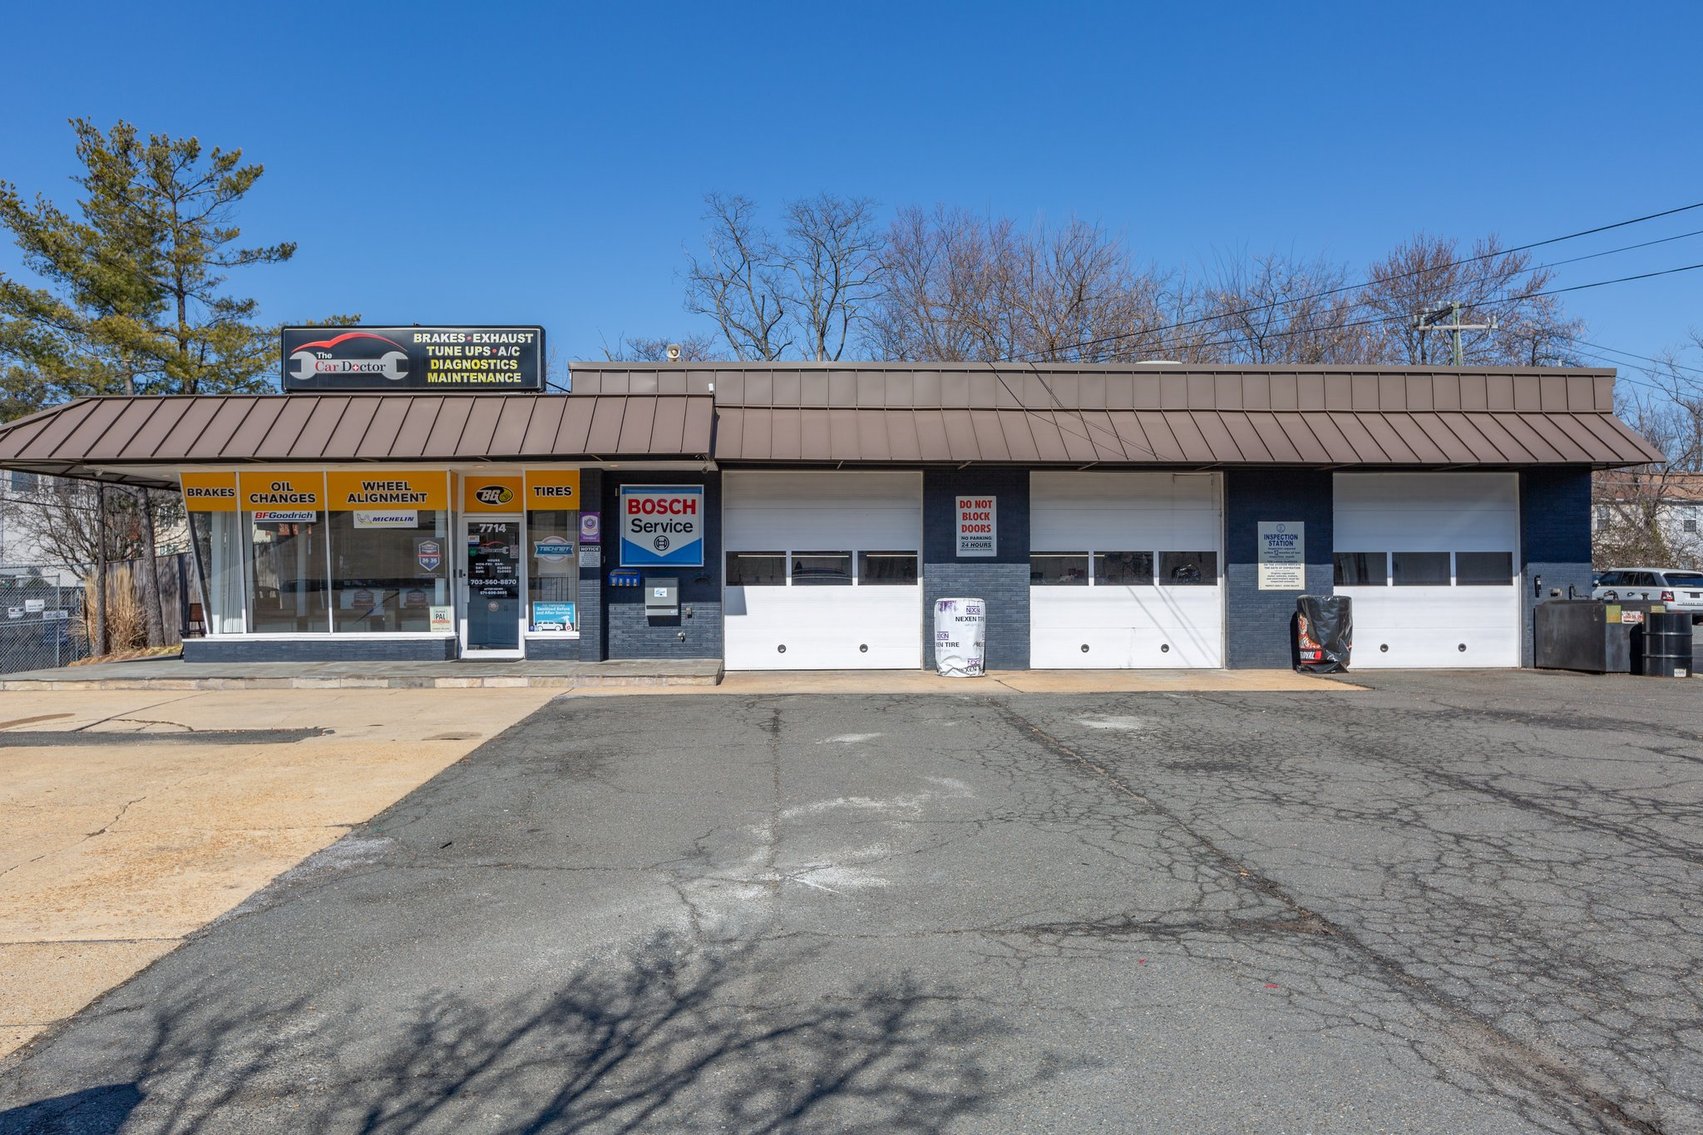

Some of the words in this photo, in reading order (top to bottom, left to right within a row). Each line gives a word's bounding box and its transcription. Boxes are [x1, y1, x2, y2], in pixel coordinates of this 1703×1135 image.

[414, 333, 465, 343] BRAKES
[472, 333, 533, 343] EXHAUST
[427, 346, 462, 356] TUNE
[465, 346, 490, 356] UPS
[498, 346, 520, 356] A/C
[314, 360, 339, 372] Car
[342, 360, 387, 372] Doctor
[430, 359, 518, 370] DIAGNOSTICS
[427, 372, 522, 383] MAINTENANCE
[271, 482, 294, 492] OIL
[362, 481, 411, 491] WHEEL
[187, 488, 235, 497] BRAKES
[534, 486, 572, 497] TIRES
[249, 493, 316, 503] CHANGES
[347, 493, 427, 503] ALIGNMENT
[628, 498, 696, 515] BOSCH
[959, 500, 972, 509] DO
[975, 500, 993, 509] NOT
[255, 511, 313, 520] BFGoodrich
[962, 512, 990, 521] BLOCK
[479, 523, 507, 533] 7714
[630, 518, 693, 534] Service
[961, 524, 992, 533] DOORS
